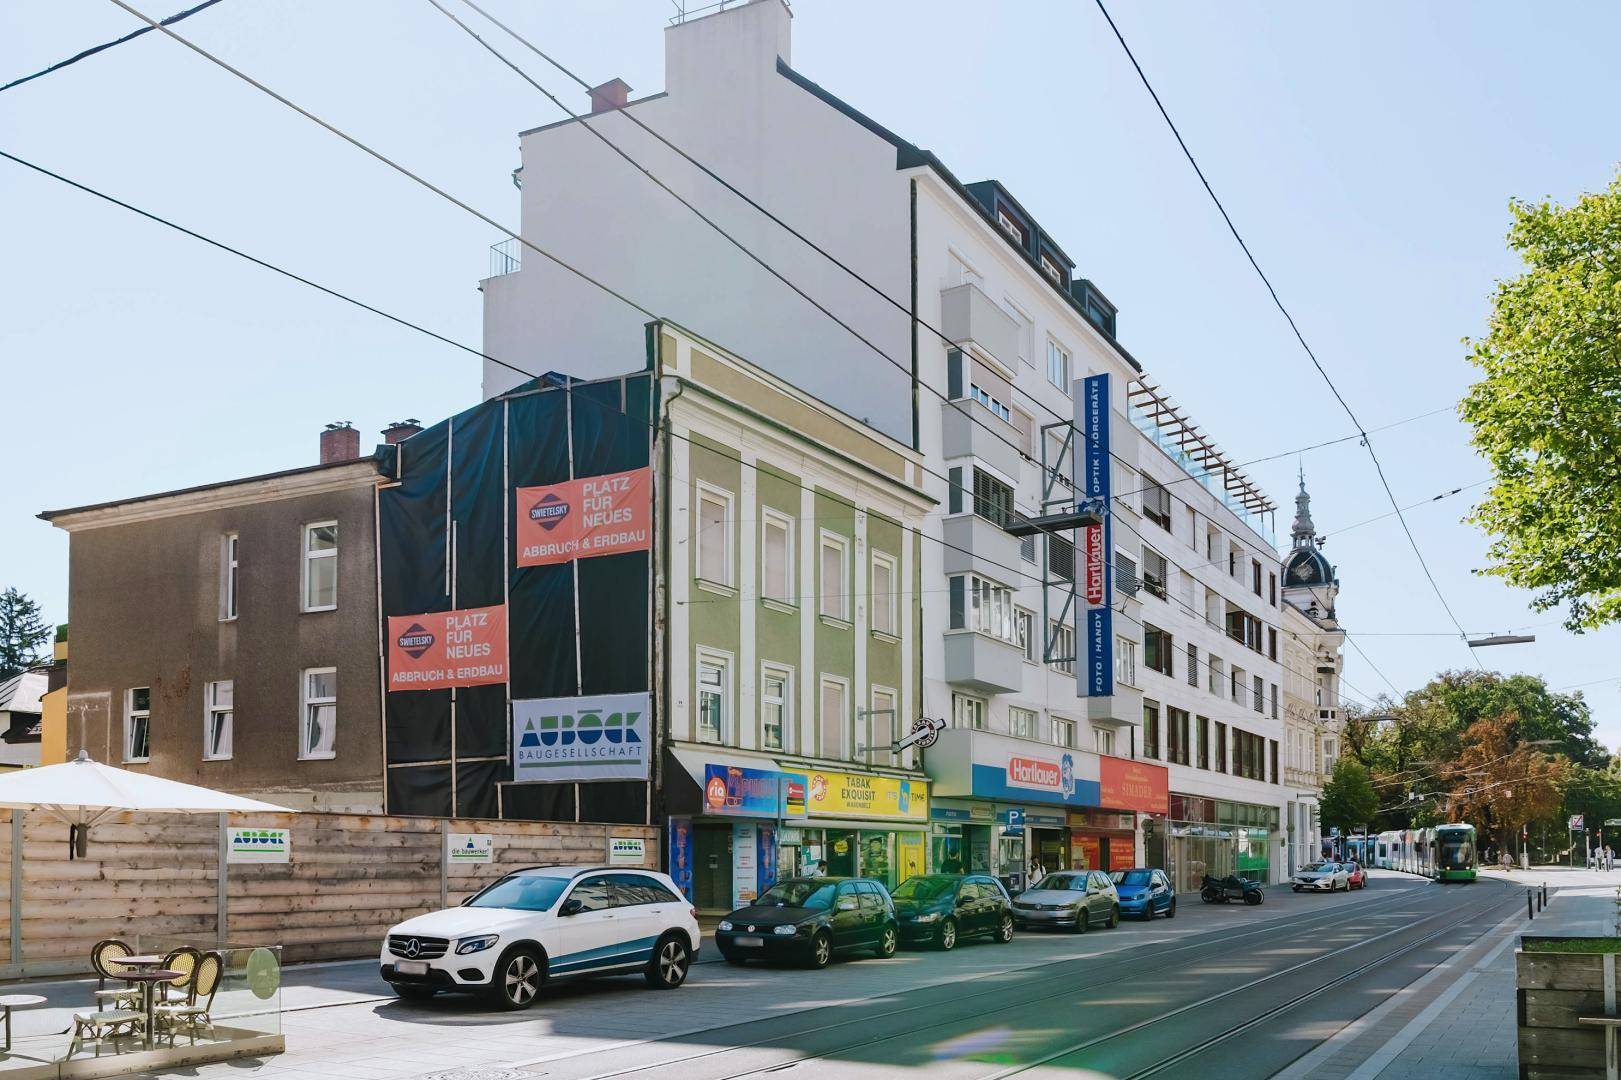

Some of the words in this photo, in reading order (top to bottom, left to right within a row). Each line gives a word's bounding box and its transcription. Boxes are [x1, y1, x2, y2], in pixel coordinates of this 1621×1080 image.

[583, 477, 630, 497] PLATZ
[531, 504, 568, 519] SWIETELSKY
[583, 493, 612, 513] FÜR
[583, 508, 632, 528] NEUES
[523, 540, 579, 558] ABBRUCH
[582, 537, 590, 549] &
[594, 530, 645, 548] ERDBAU
[1089, 527, 1101, 600] Hartlauer
[446, 613, 488, 630] PLATZ
[400, 635, 432, 647] SWIETELSKY
[446, 626, 472, 644] FÜR
[446, 643, 490, 659] NEUES
[392, 670, 444, 683] ABBRUCH
[447, 669, 455, 679] &
[457, 664, 503, 678] ERDBAU
[520, 709, 642, 747] AUBÖCK
[519, 746, 641, 760] BAUGESELLSCHAFT
[1013, 758, 1058, 785] Hartlauer
[846, 776, 871, 789] TABAK
[841, 788, 876, 801] EXQUISIT
[911, 793, 925, 802] TIME
[1009, 811, 1019, 824] P
